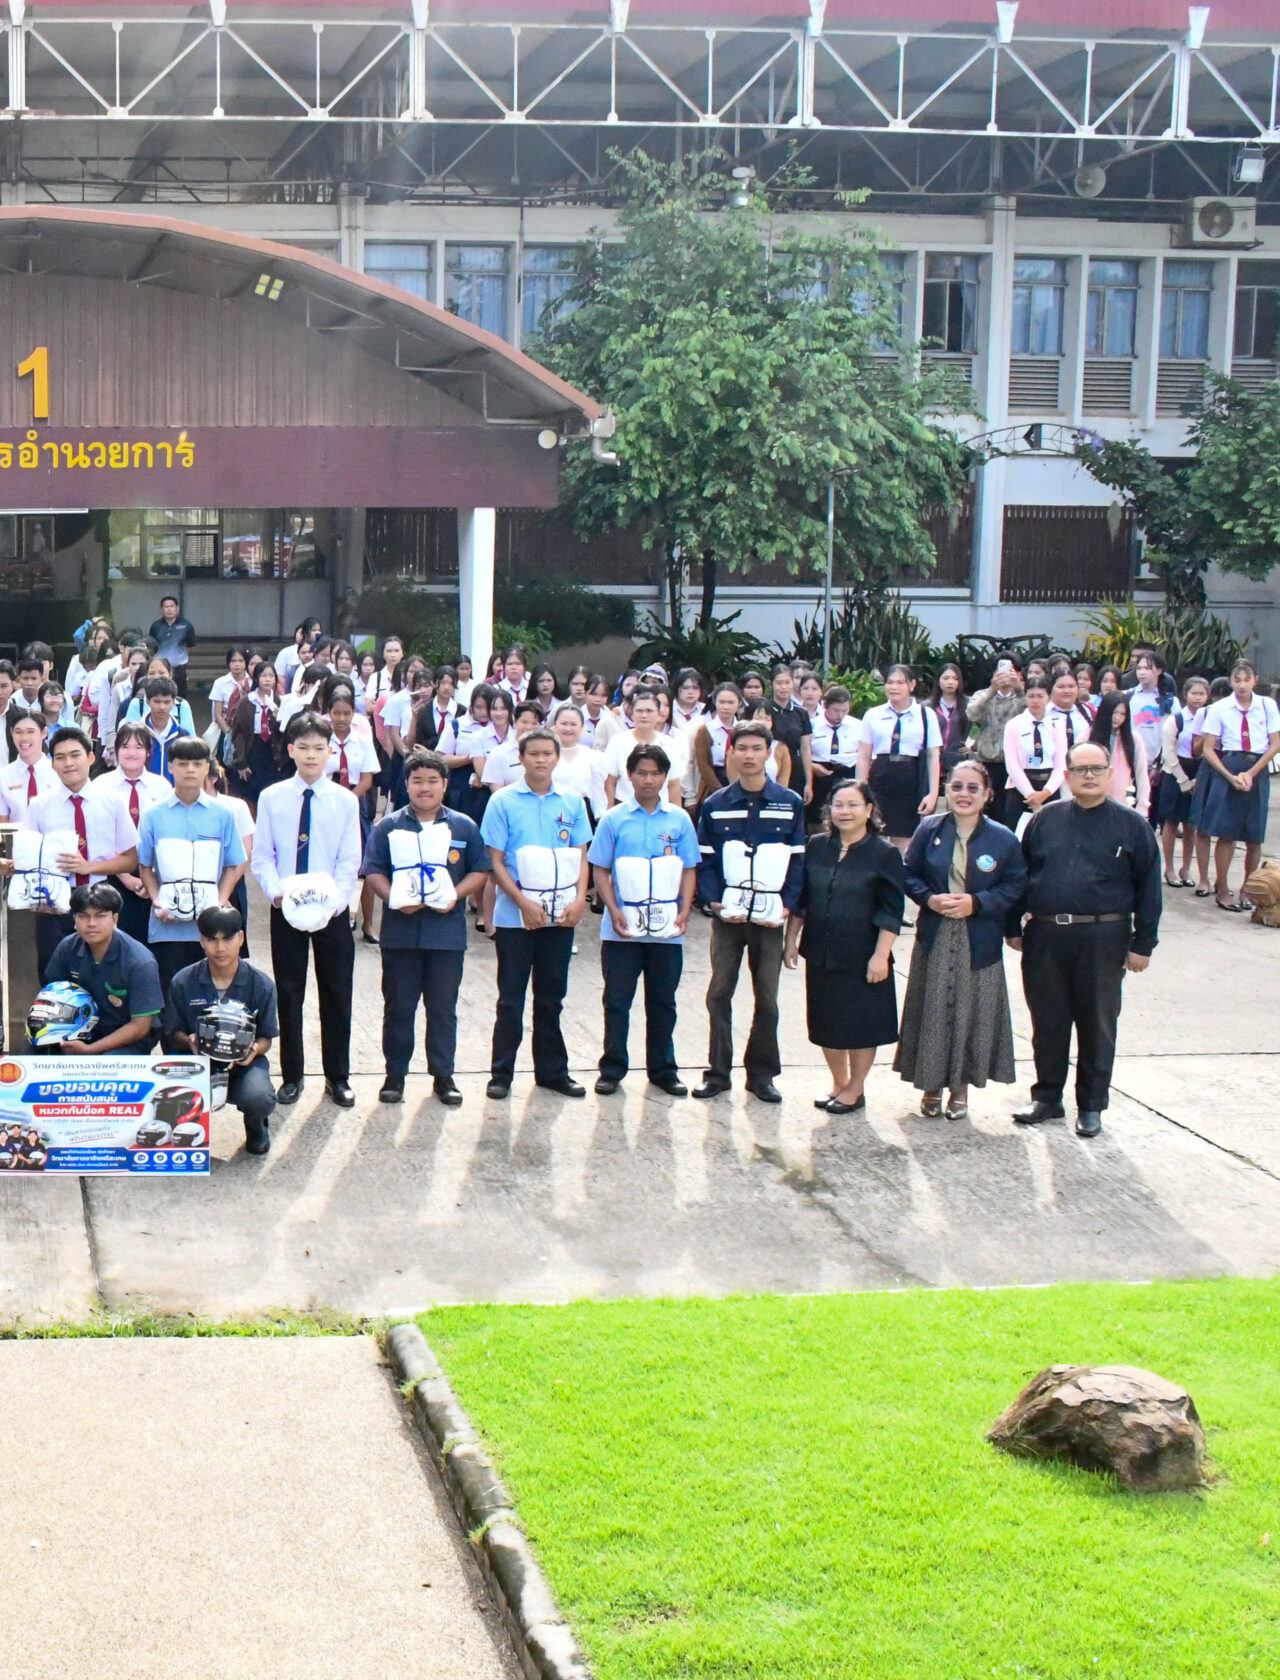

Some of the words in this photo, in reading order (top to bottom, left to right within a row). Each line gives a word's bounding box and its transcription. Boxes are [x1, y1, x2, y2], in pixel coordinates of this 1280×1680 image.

[17, 346, 50, 418] 1
[38, 1081, 140, 1096] ขอขอบคุณ
[58, 1094, 118, 1104] การสนับสนุน
[108, 1106, 140, 1115] REAL
